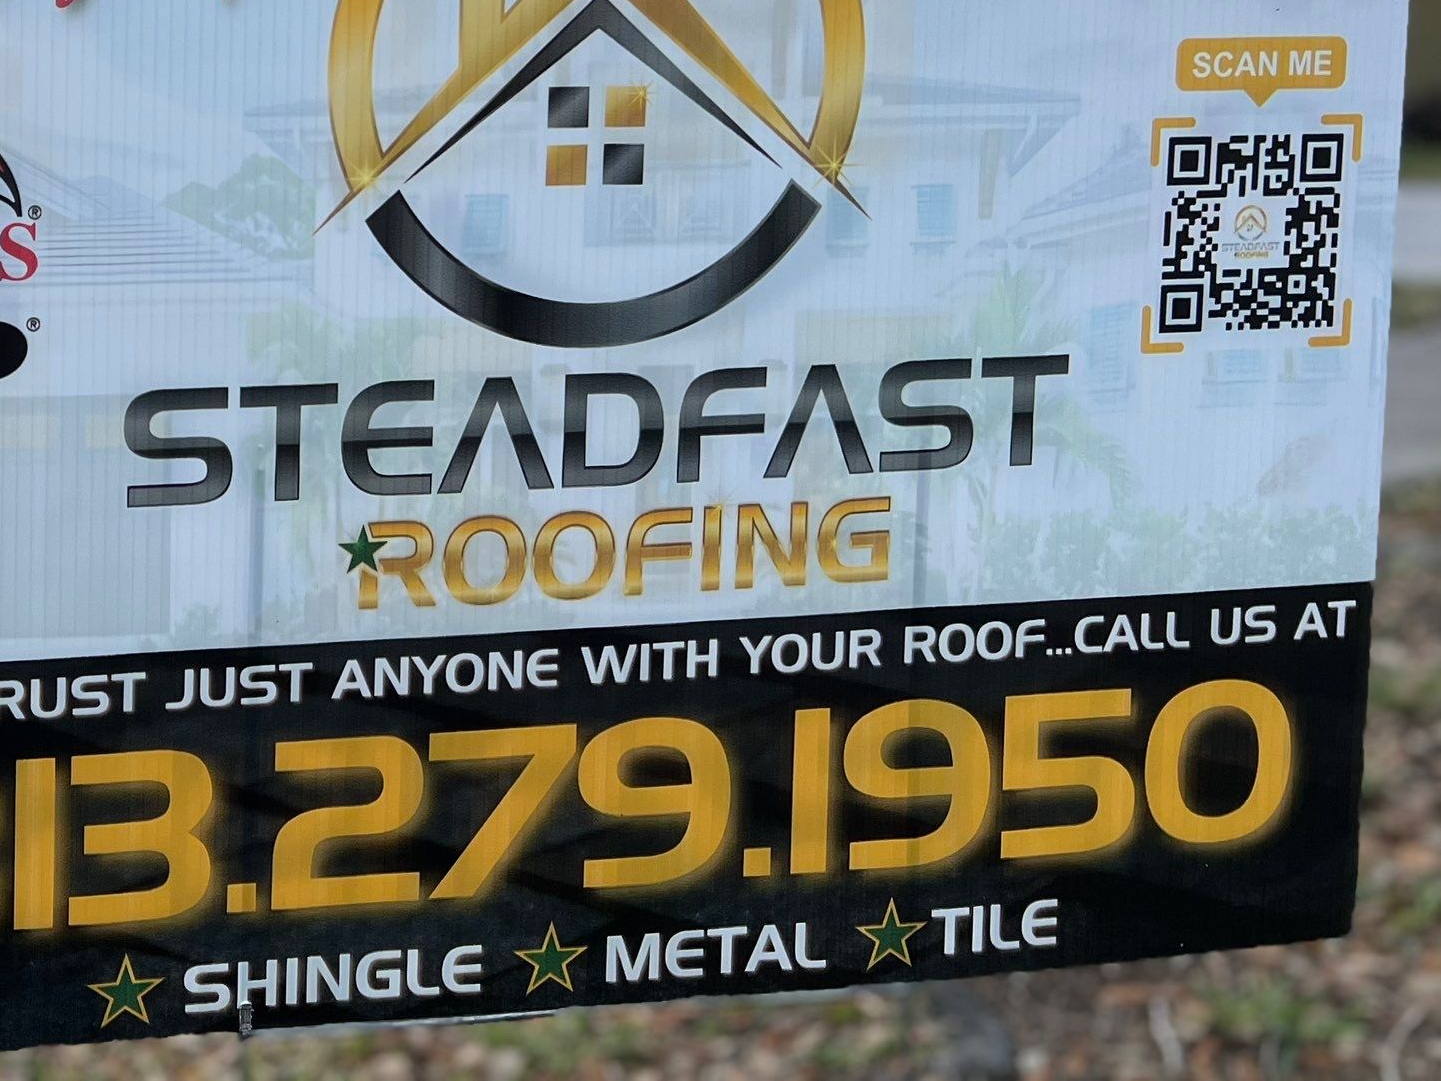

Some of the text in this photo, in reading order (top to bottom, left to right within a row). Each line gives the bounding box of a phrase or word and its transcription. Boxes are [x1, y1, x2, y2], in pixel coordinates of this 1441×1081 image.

[1192, 50, 1332, 79] SCAN ME
[123, 354, 1070, 509] STEADFAST
[357, 495, 892, 611] ROOFING
[165, 661, 314, 710] JUST
[331, 648, 560, 701] ANYONE
[580, 638, 720, 686] WITH
[739, 628, 881, 677] YOUR
[1210, 605, 1277, 645] US
[1294, 600, 1357, 641] AT
[183, 898, 1059, 1014] SHINGLE METAL TILE
